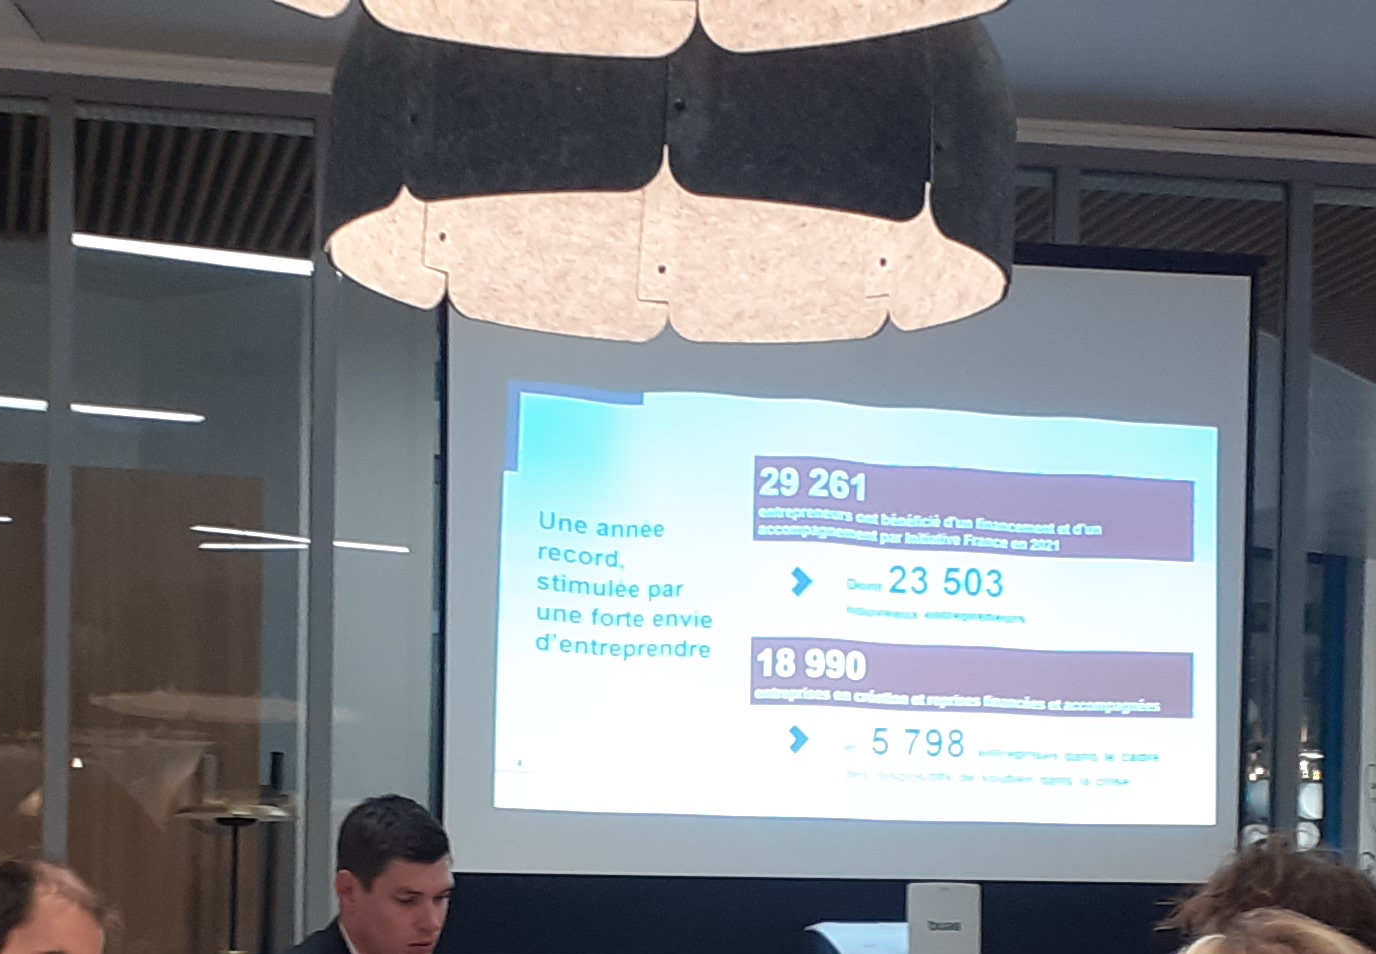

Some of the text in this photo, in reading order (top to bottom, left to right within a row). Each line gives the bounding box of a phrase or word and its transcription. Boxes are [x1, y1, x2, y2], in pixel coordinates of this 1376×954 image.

[758, 466, 866, 502] 29 261
[538, 510, 666, 538] Une année
[536, 573, 685, 602] stimulée par
[888, 565, 929, 595] 23
[943, 567, 1004, 598] 503
[536, 606, 714, 629] une forte envie
[535, 633, 712, 662] d'entreprendre
[756, 647, 867, 681] 18 990
[872, 727, 965, 758] 5 798
